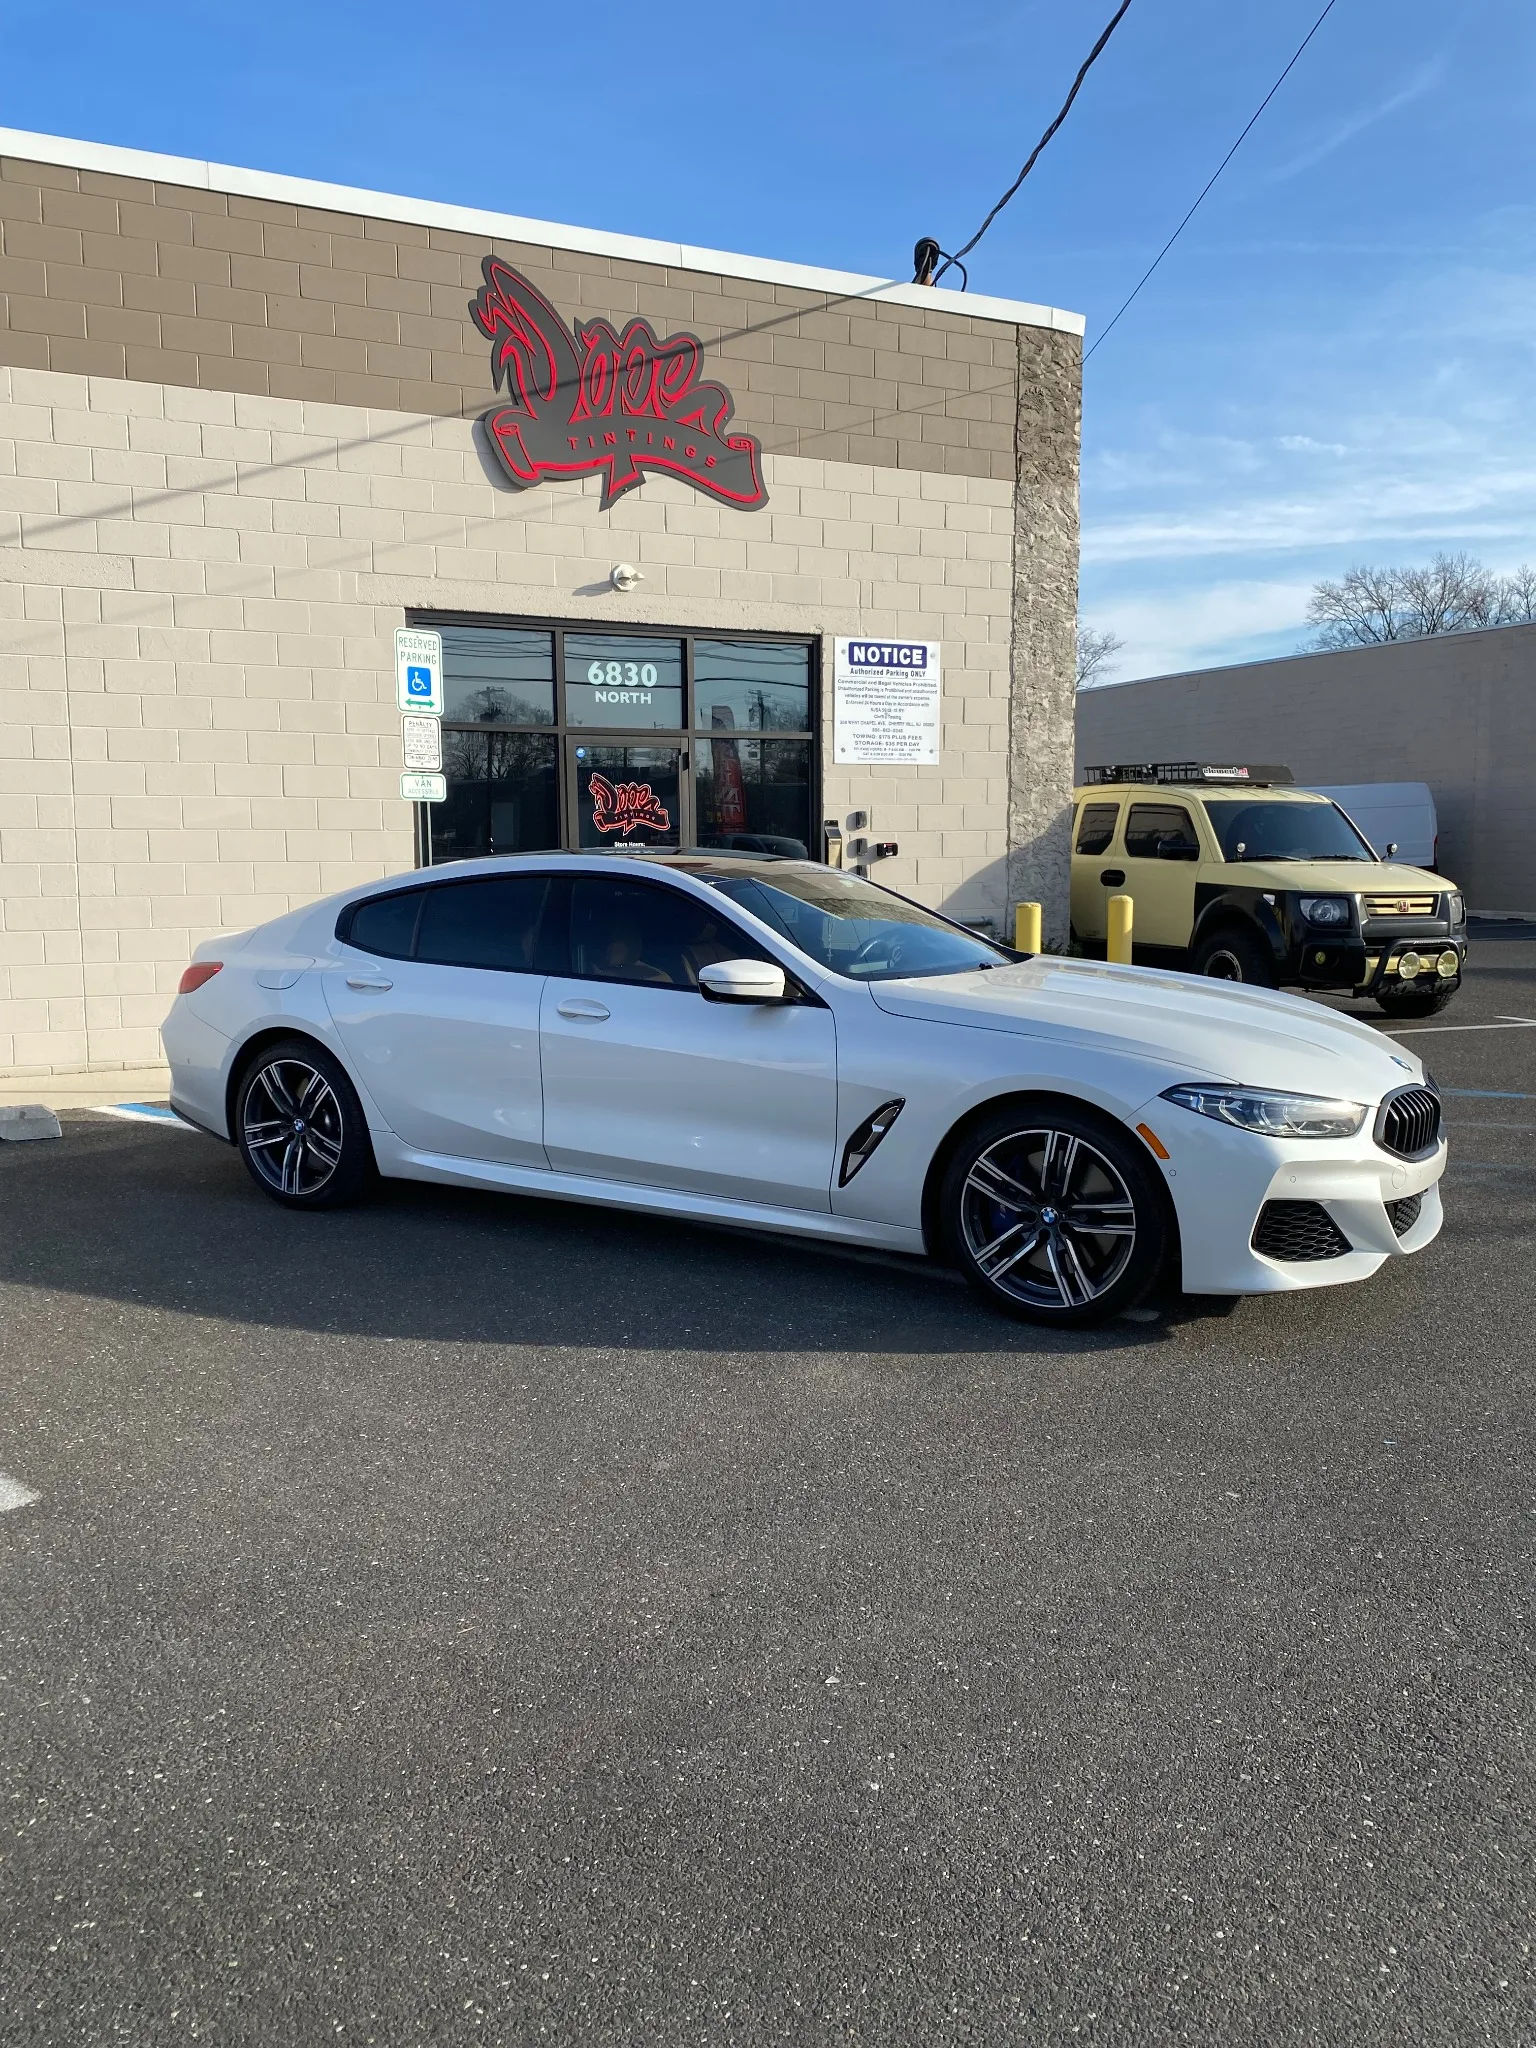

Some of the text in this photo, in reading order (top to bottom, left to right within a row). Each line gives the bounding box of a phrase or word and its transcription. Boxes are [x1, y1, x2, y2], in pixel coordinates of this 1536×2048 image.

[567, 429, 717, 468] TINTINGS
[398, 636, 437, 650] RESERVED
[400, 651, 436, 664] PARKING
[853, 646, 923, 665] NOTICE
[587, 661, 658, 687] 6830
[886, 670, 908, 678] Parking
[595, 690, 652, 704] NORTH
